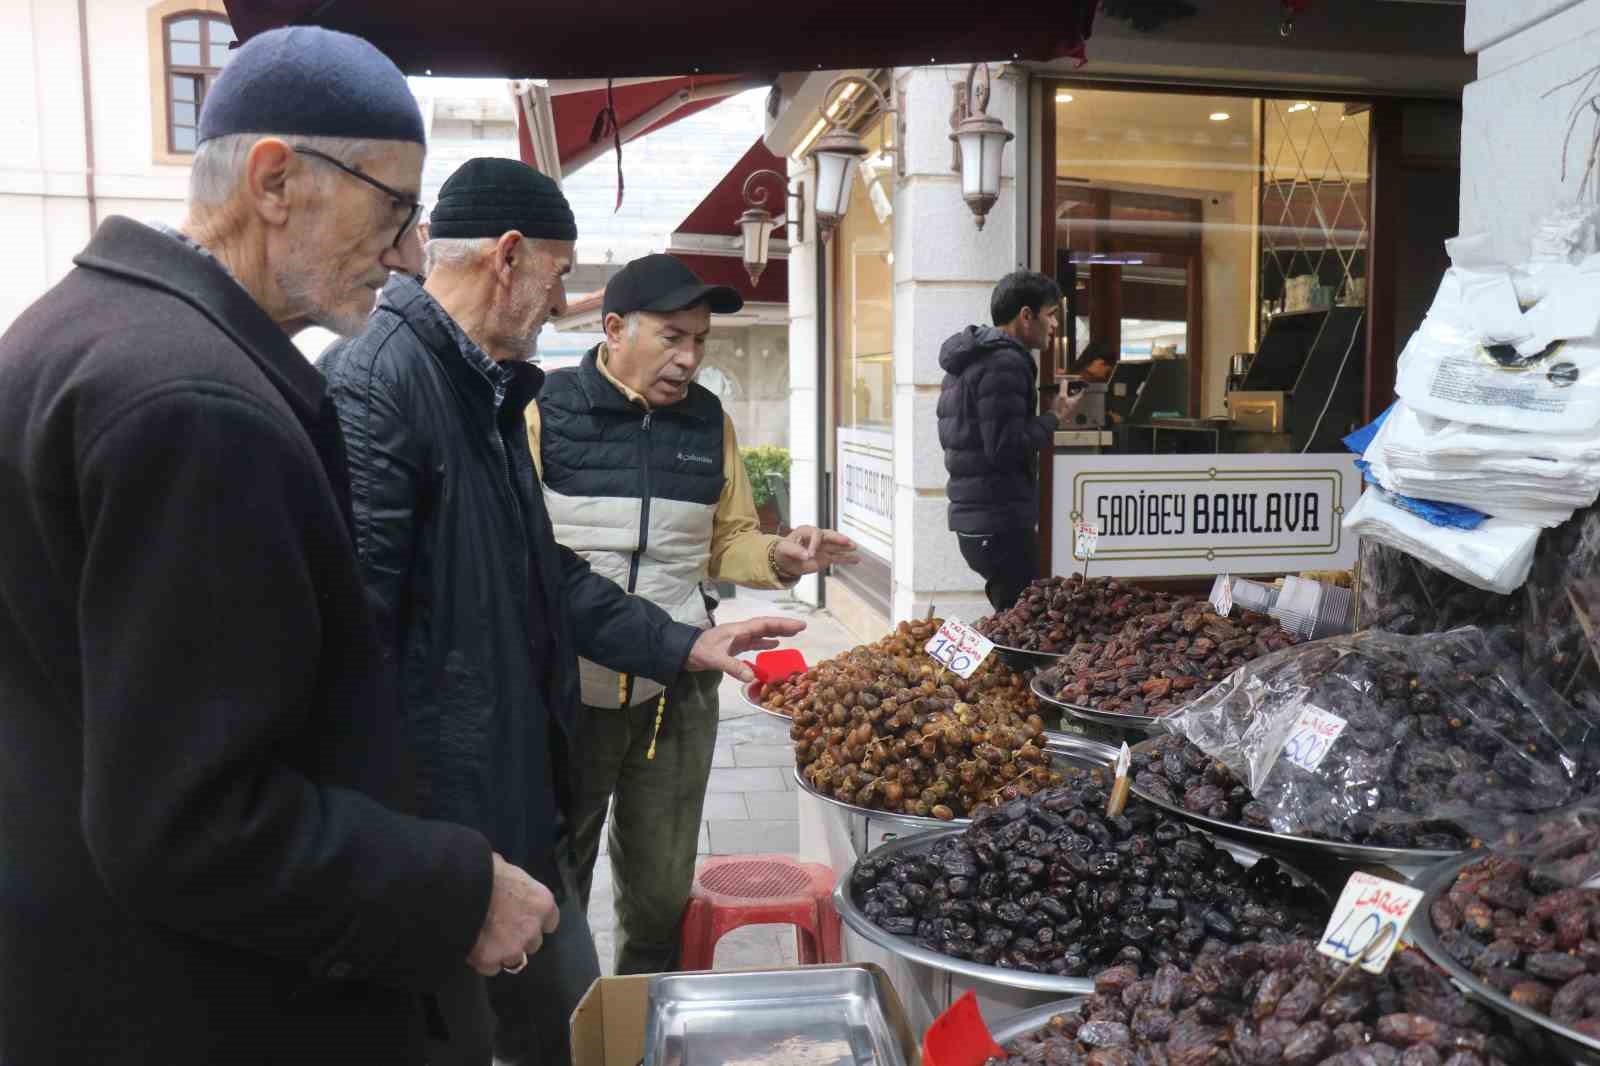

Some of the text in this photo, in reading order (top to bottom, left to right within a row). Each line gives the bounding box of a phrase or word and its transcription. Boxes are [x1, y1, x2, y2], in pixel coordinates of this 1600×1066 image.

[1193, 491, 1320, 534] BAKLAVA
[1355, 886, 1411, 916] LARGE
[1325, 909, 1398, 965] 400
